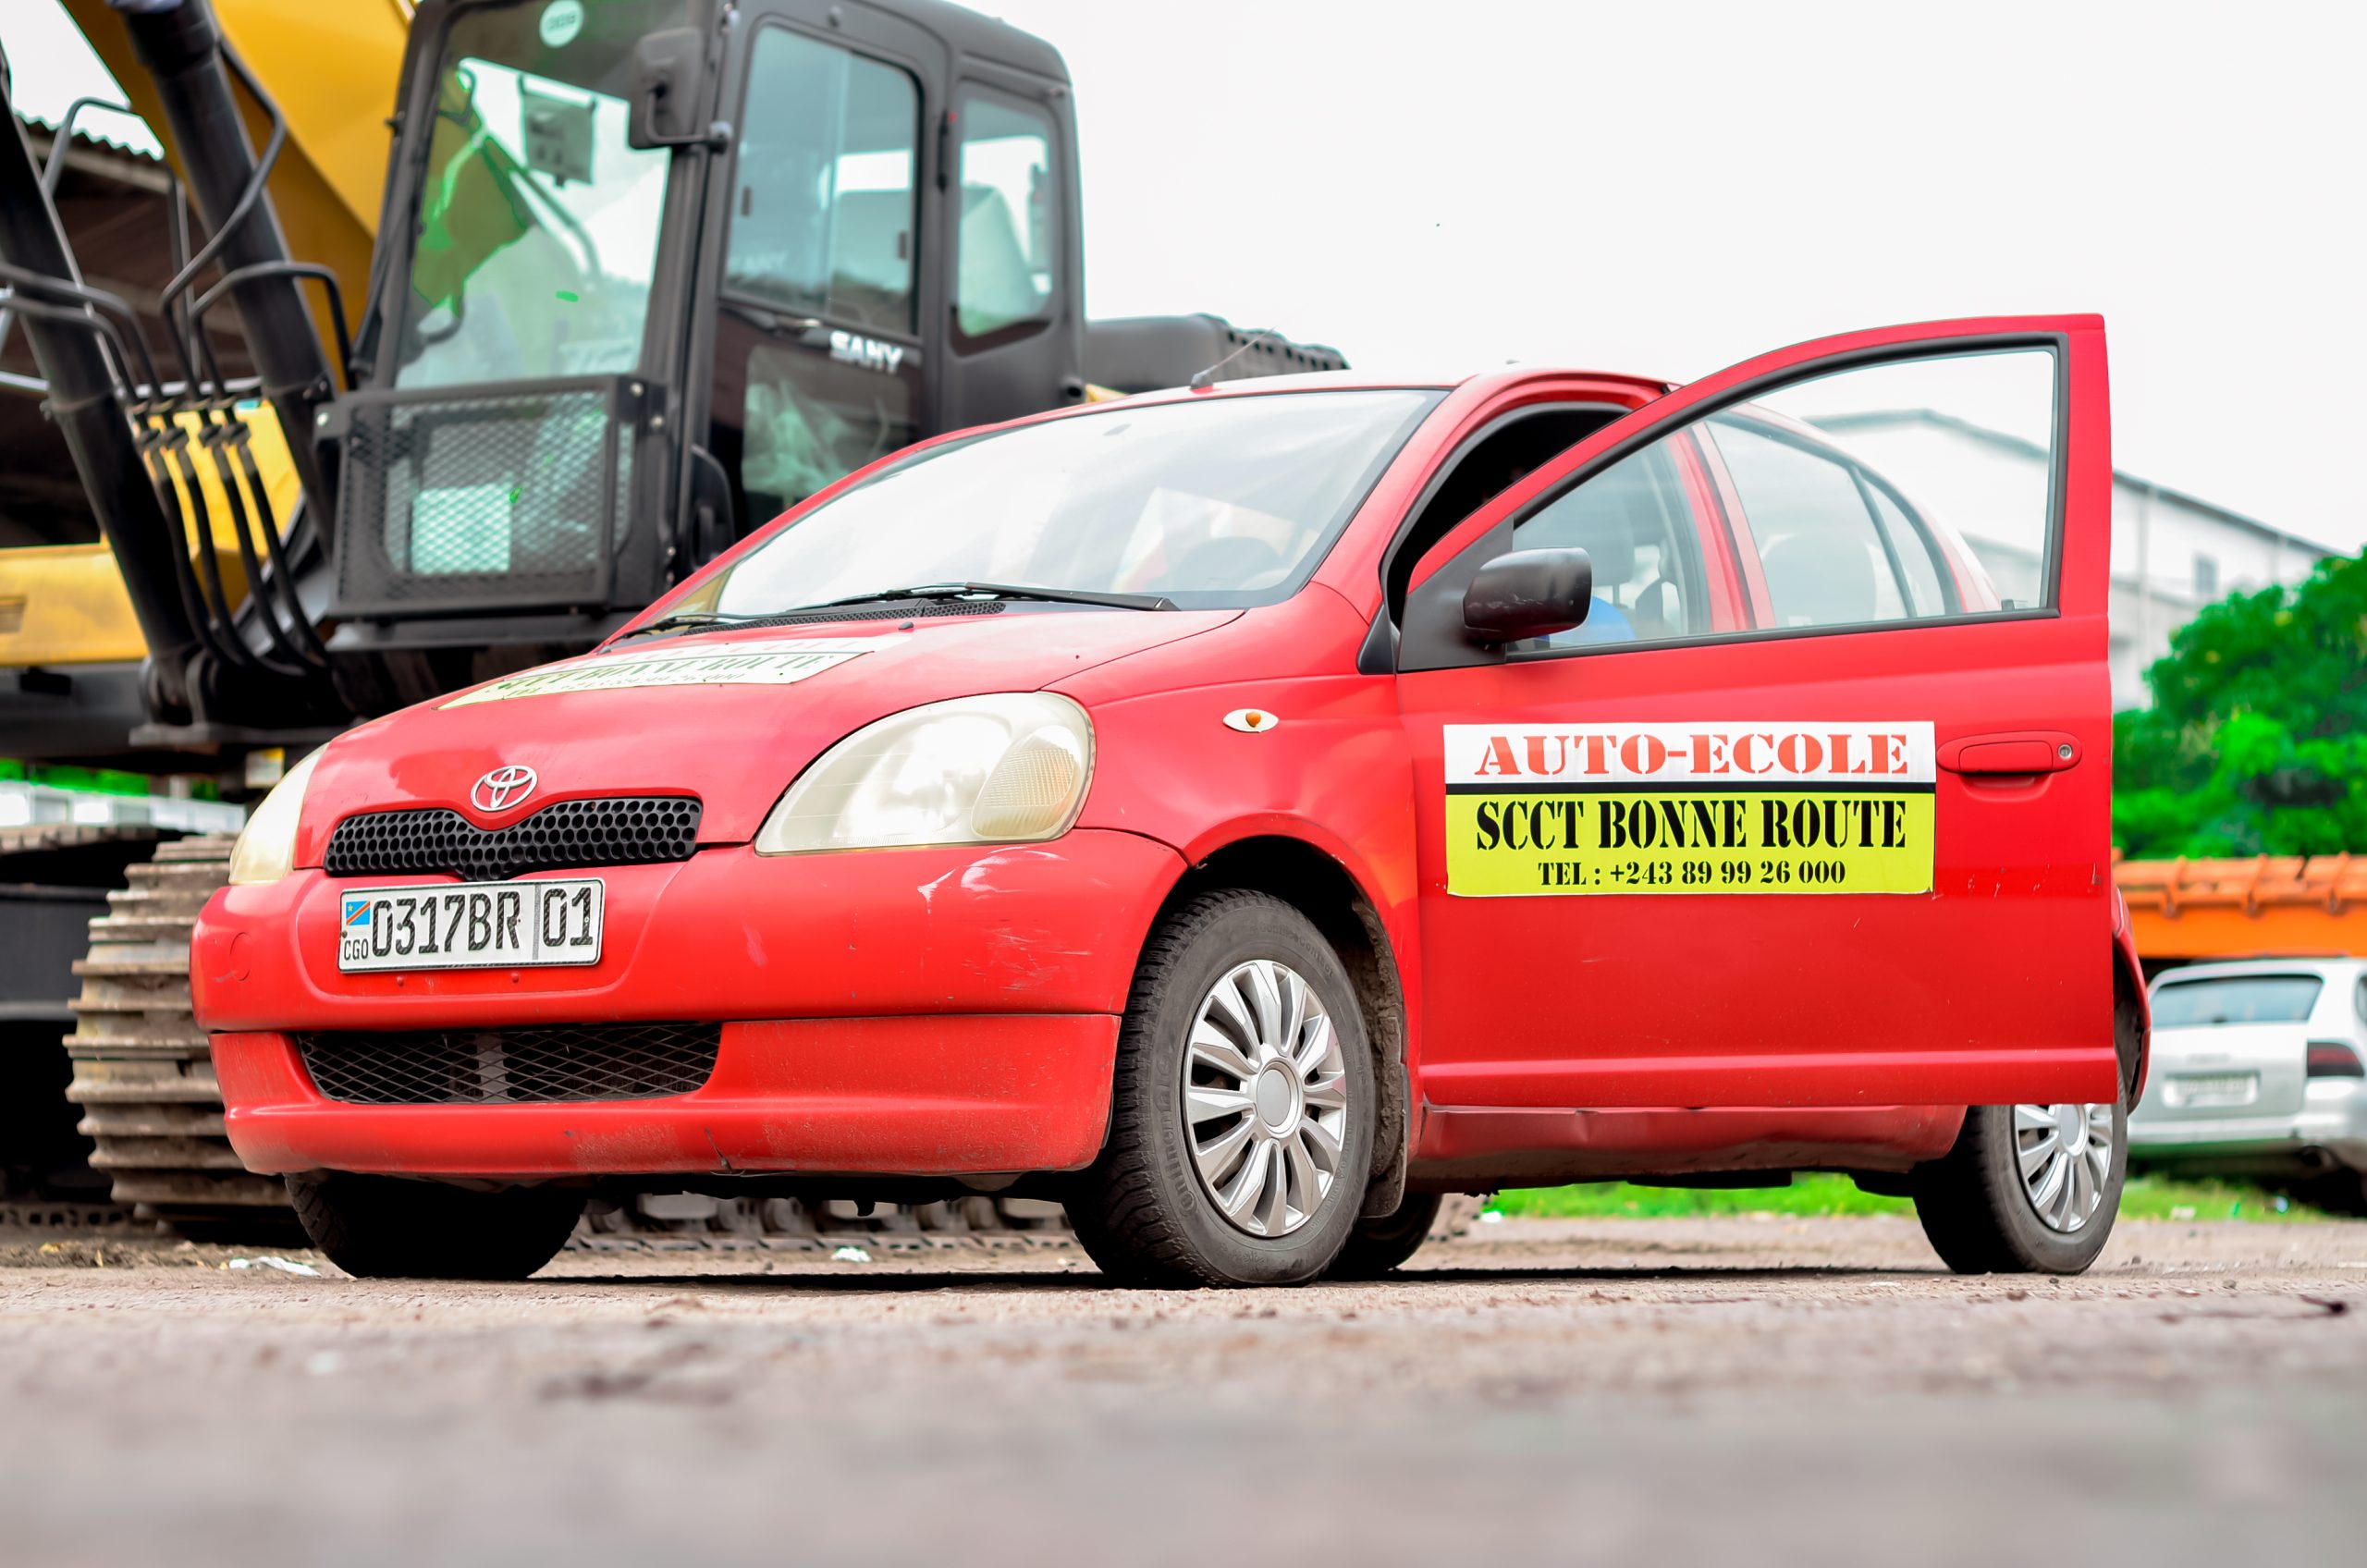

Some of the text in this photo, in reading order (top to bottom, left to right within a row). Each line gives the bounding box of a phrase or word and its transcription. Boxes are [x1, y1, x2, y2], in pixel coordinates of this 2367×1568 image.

[1474, 733, 1908, 776] AUTO-ECOLE
[1476, 799, 1907, 851] SCCT BONNE ROUTE
[1609, 861, 1674, 885] +243
[1681, 860, 1712, 885] 89
[1720, 860, 1752, 884] 99
[1760, 860, 1791, 884] 26
[1797, 860, 1846, 884] 000
[372, 887, 594, 958] 0317BR 01
[343, 938, 369, 962] CGO
